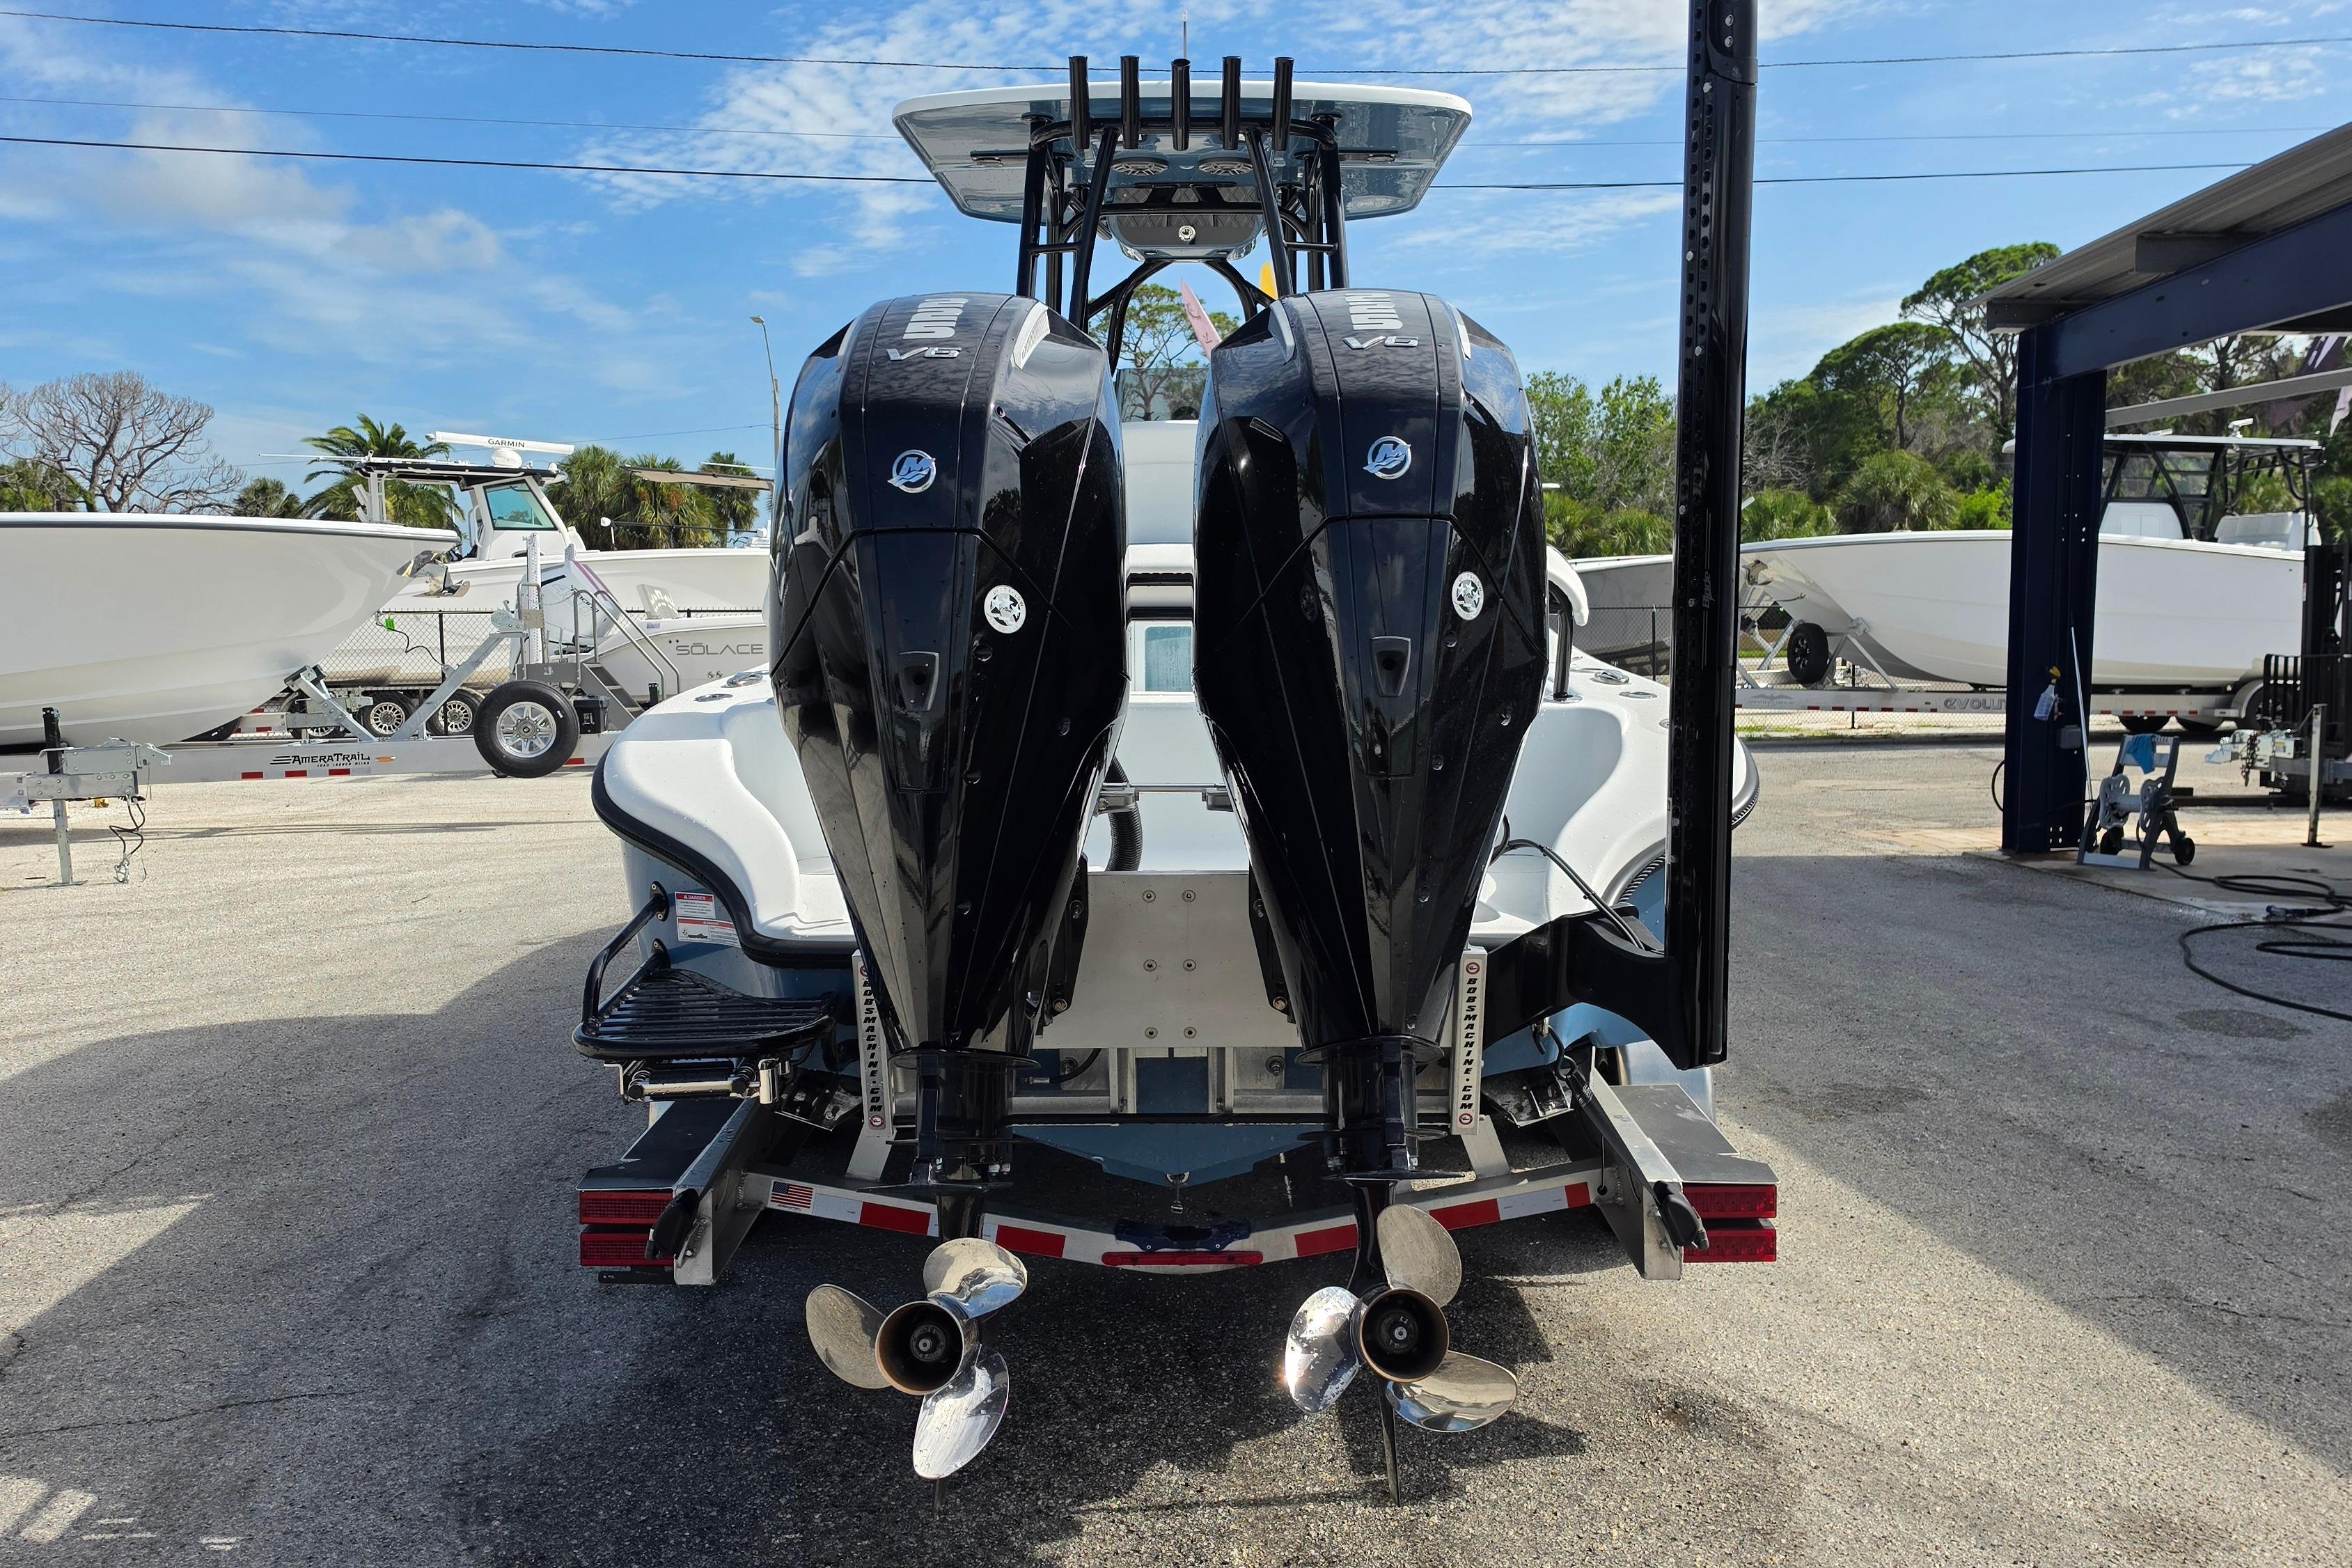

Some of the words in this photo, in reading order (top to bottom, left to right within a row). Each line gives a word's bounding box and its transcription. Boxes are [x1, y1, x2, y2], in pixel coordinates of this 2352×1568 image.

[1342, 336, 1418, 350] V6
[886, 347, 962, 361] V6
[487, 439, 525, 448] GARMIN
[1459, 978, 1477, 1110] BOBSMACHINE.COM
